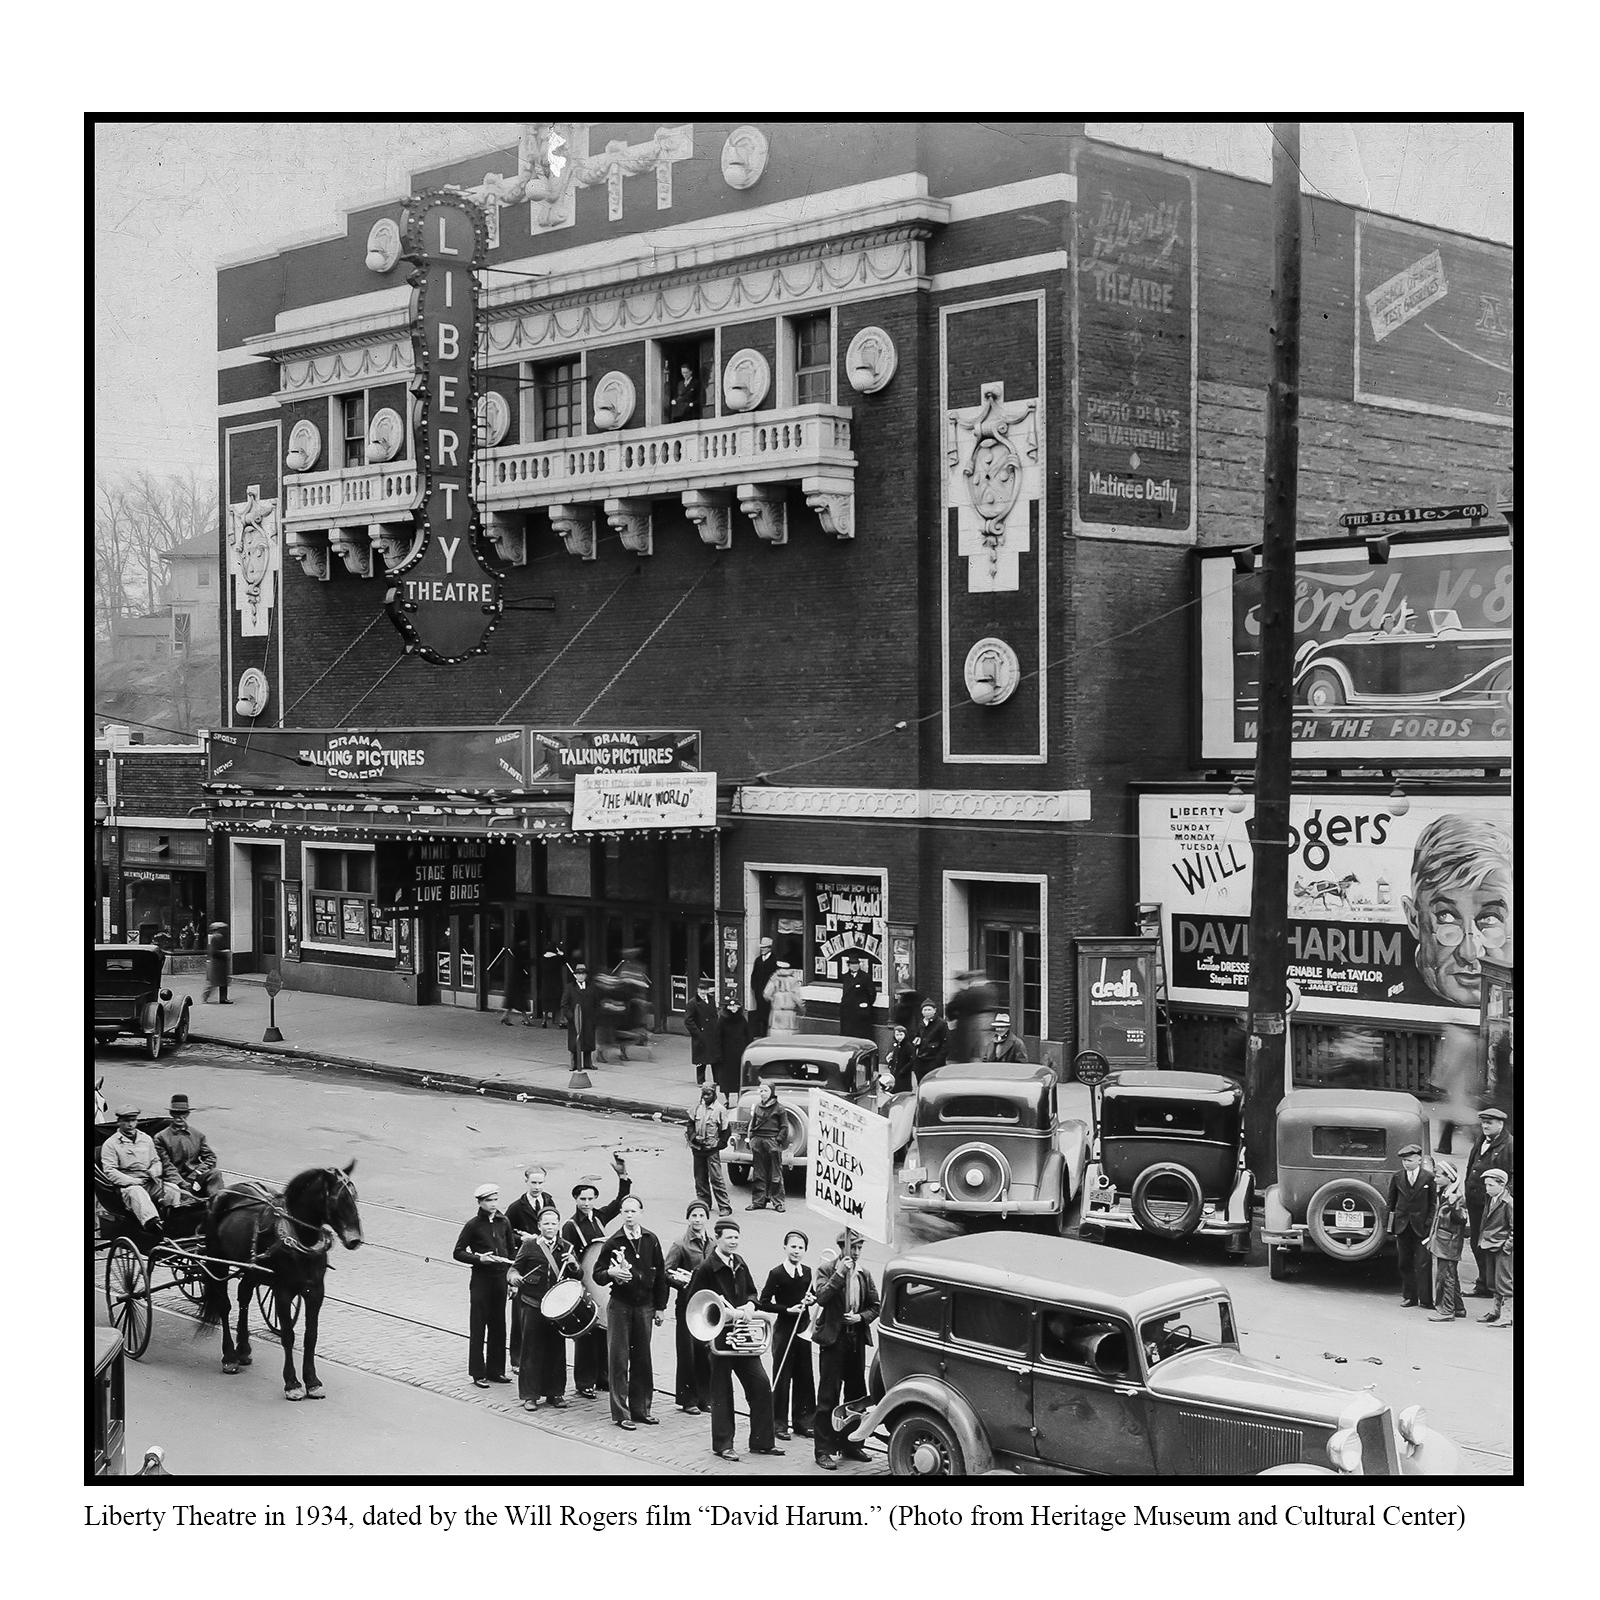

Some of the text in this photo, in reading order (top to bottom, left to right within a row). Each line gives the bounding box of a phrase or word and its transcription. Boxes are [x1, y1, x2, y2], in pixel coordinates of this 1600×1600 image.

[1093, 270, 1174, 314] THEATRE
[438, 216, 461, 574] LIBERTY
[1089, 472, 1178, 514] Matinee Daily
[1347, 505, 1482, 526] THE Bailey CO.
[406, 581, 492, 602] THEATRE
[495, 731, 520, 745] MUSIC
[1331, 720, 1373, 738] THE
[1390, 718, 1473, 738] FORDS
[213, 732, 237, 745] SPORTS
[329, 735, 382, 750] DRAMA
[594, 733, 639, 746] DRAMA
[299, 749, 425, 769] TALKING PICTURES
[559, 747, 674, 767] TALKING PICTURES
[213, 759, 233, 776] NEWS
[328, 766, 385, 779] COMEDY
[499, 757, 524, 783] TRAVEL
[623, 790, 653, 808] MIMIC
[1170, 806, 1224, 819] LIBERTY
[1170, 823, 1211, 832] SUNDAY
[1174, 833, 1215, 841] MONDAY
[421, 842, 486, 859] MIMIC WORLD
[415, 863, 483, 880] STAGE REVUE
[1171, 844, 1246, 896] WILL
[1179, 920, 1249, 956] DAVI
[1091, 957, 1139, 998] death
[1220, 961, 1250, 973] DRESSE
[1326, 968, 1346, 980] Kent
[1346, 968, 1383, 983] TAYLOR
[819, 1120, 848, 1150] WILL
[817, 1139, 865, 1177] ROGERS
[816, 1159, 854, 1193] DAVID
[815, 1179, 867, 1220] HARUM
